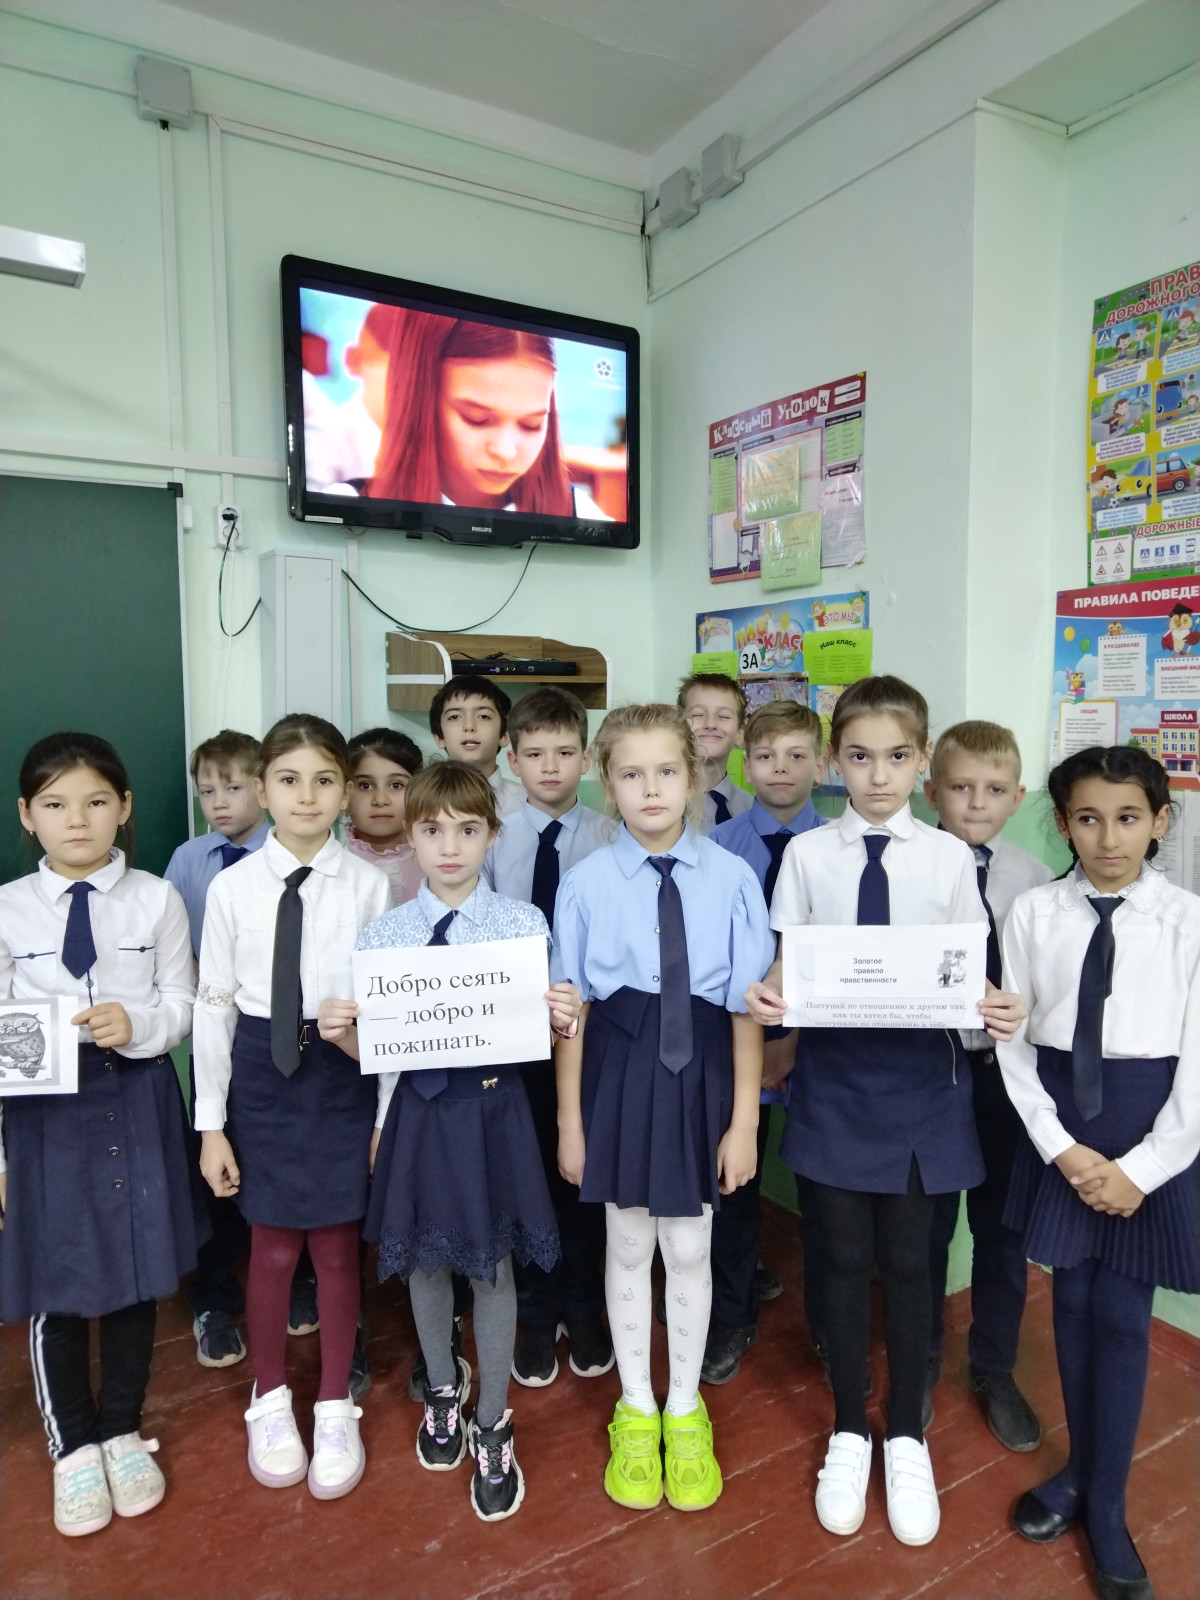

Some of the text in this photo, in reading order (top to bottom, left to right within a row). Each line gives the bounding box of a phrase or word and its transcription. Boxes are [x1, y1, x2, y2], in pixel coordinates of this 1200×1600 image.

[1105, 282, 1200, 325] ДОРОЖНОГО
[1074, 585, 1200, 609] ПРАВИЛА ПОВЕДЕ
[823, 611, 855, 625] ЭТО МЫ
[820, 639, 857, 650] Наш класс
[742, 653, 758, 669] 3А
[1164, 712, 1194, 720] ШКОЛА
[853, 957, 883, 965] Золотое
[853, 967, 884, 975] правило
[367, 970, 511, 998] Добро сеять
[839, 976, 898, 984] нравственности
[806, 1001, 846, 1011] Поступай
[917, 1003, 948, 1012] другим
[405, 1002, 474, 1025] добро
[482, 1003, 495, 1016] и
[889, 1011, 904, 1020] бы,
[906, 1011, 932, 1019] чтобы
[373, 1033, 492, 1056] пожинать.
